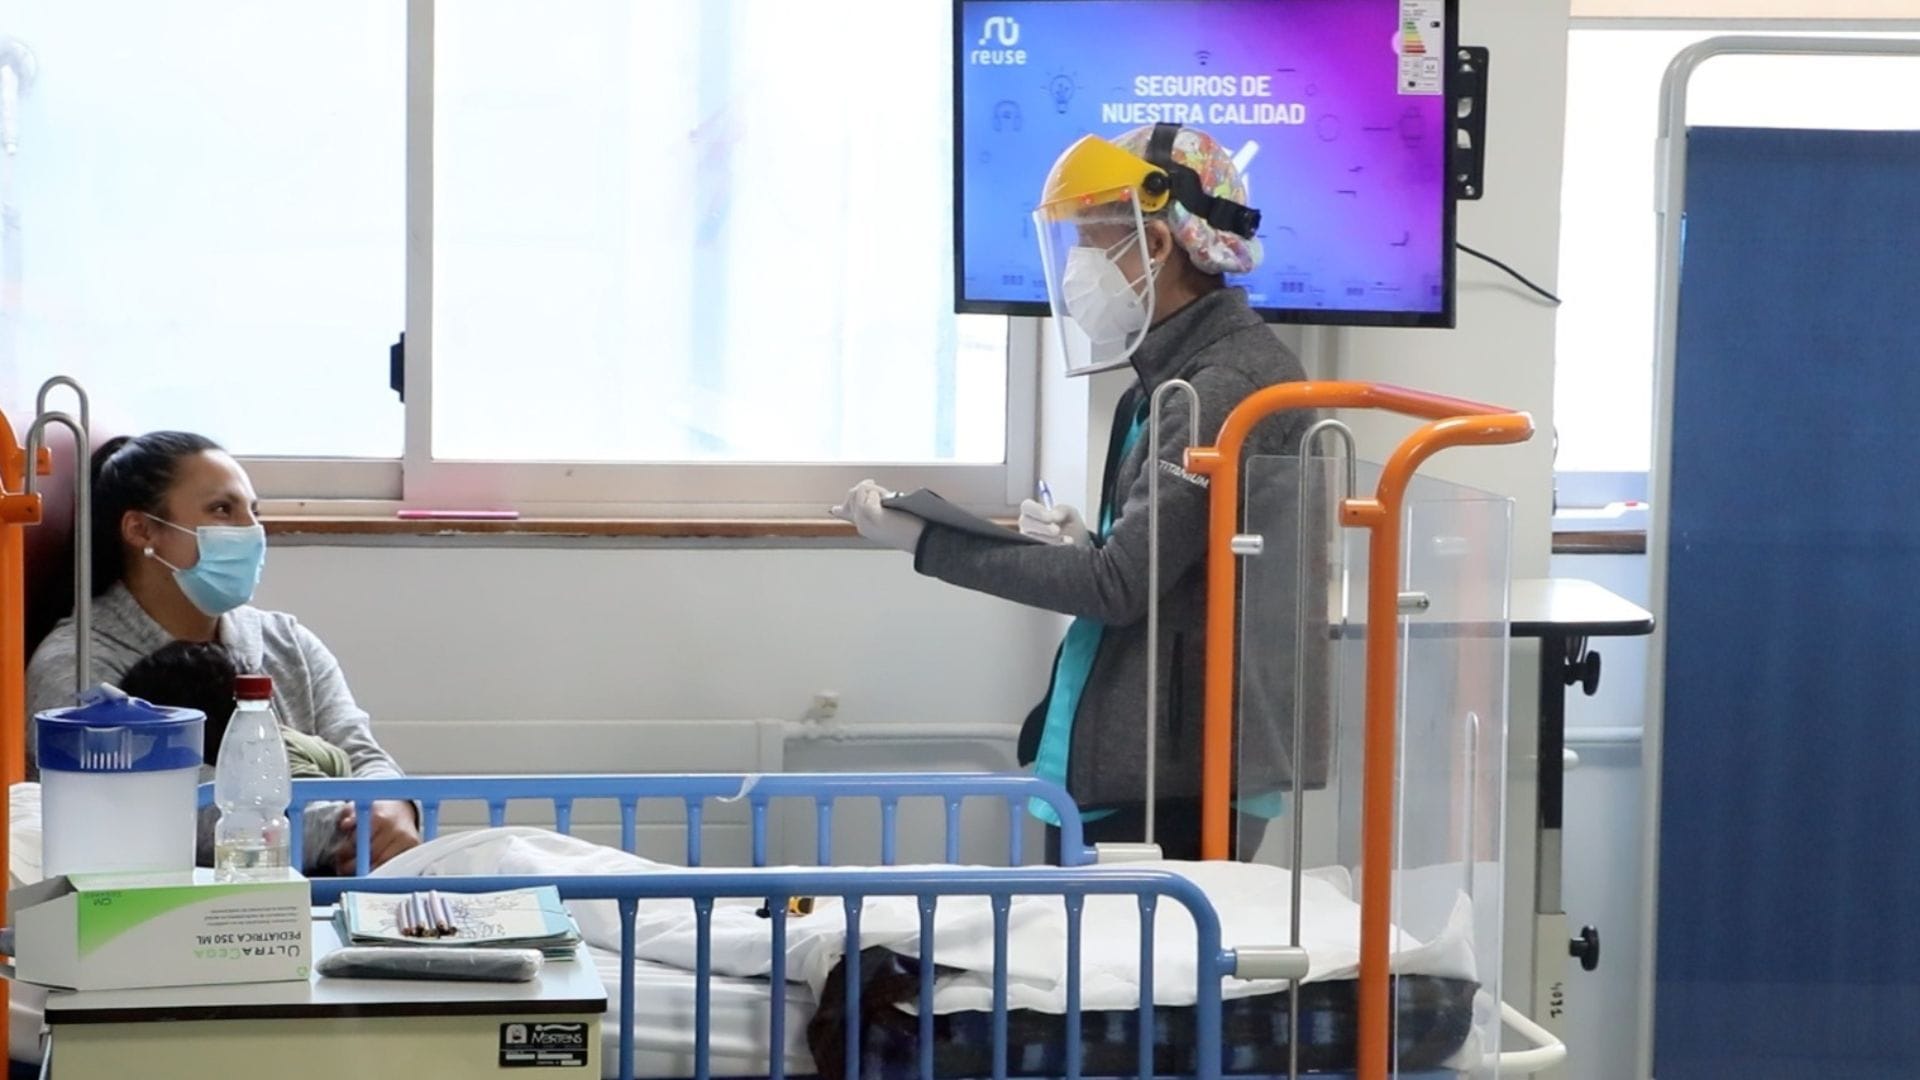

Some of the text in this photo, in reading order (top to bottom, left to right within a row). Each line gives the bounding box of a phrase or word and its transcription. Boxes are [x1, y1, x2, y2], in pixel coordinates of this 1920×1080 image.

[971, 45, 1028, 66] reuse
[1134, 75, 1272, 97] SEGUROS DE
[1101, 102, 1306, 125] NUESTRA CALIDAD
[196, 931, 302, 945] PEDIATRICA 350 ML
